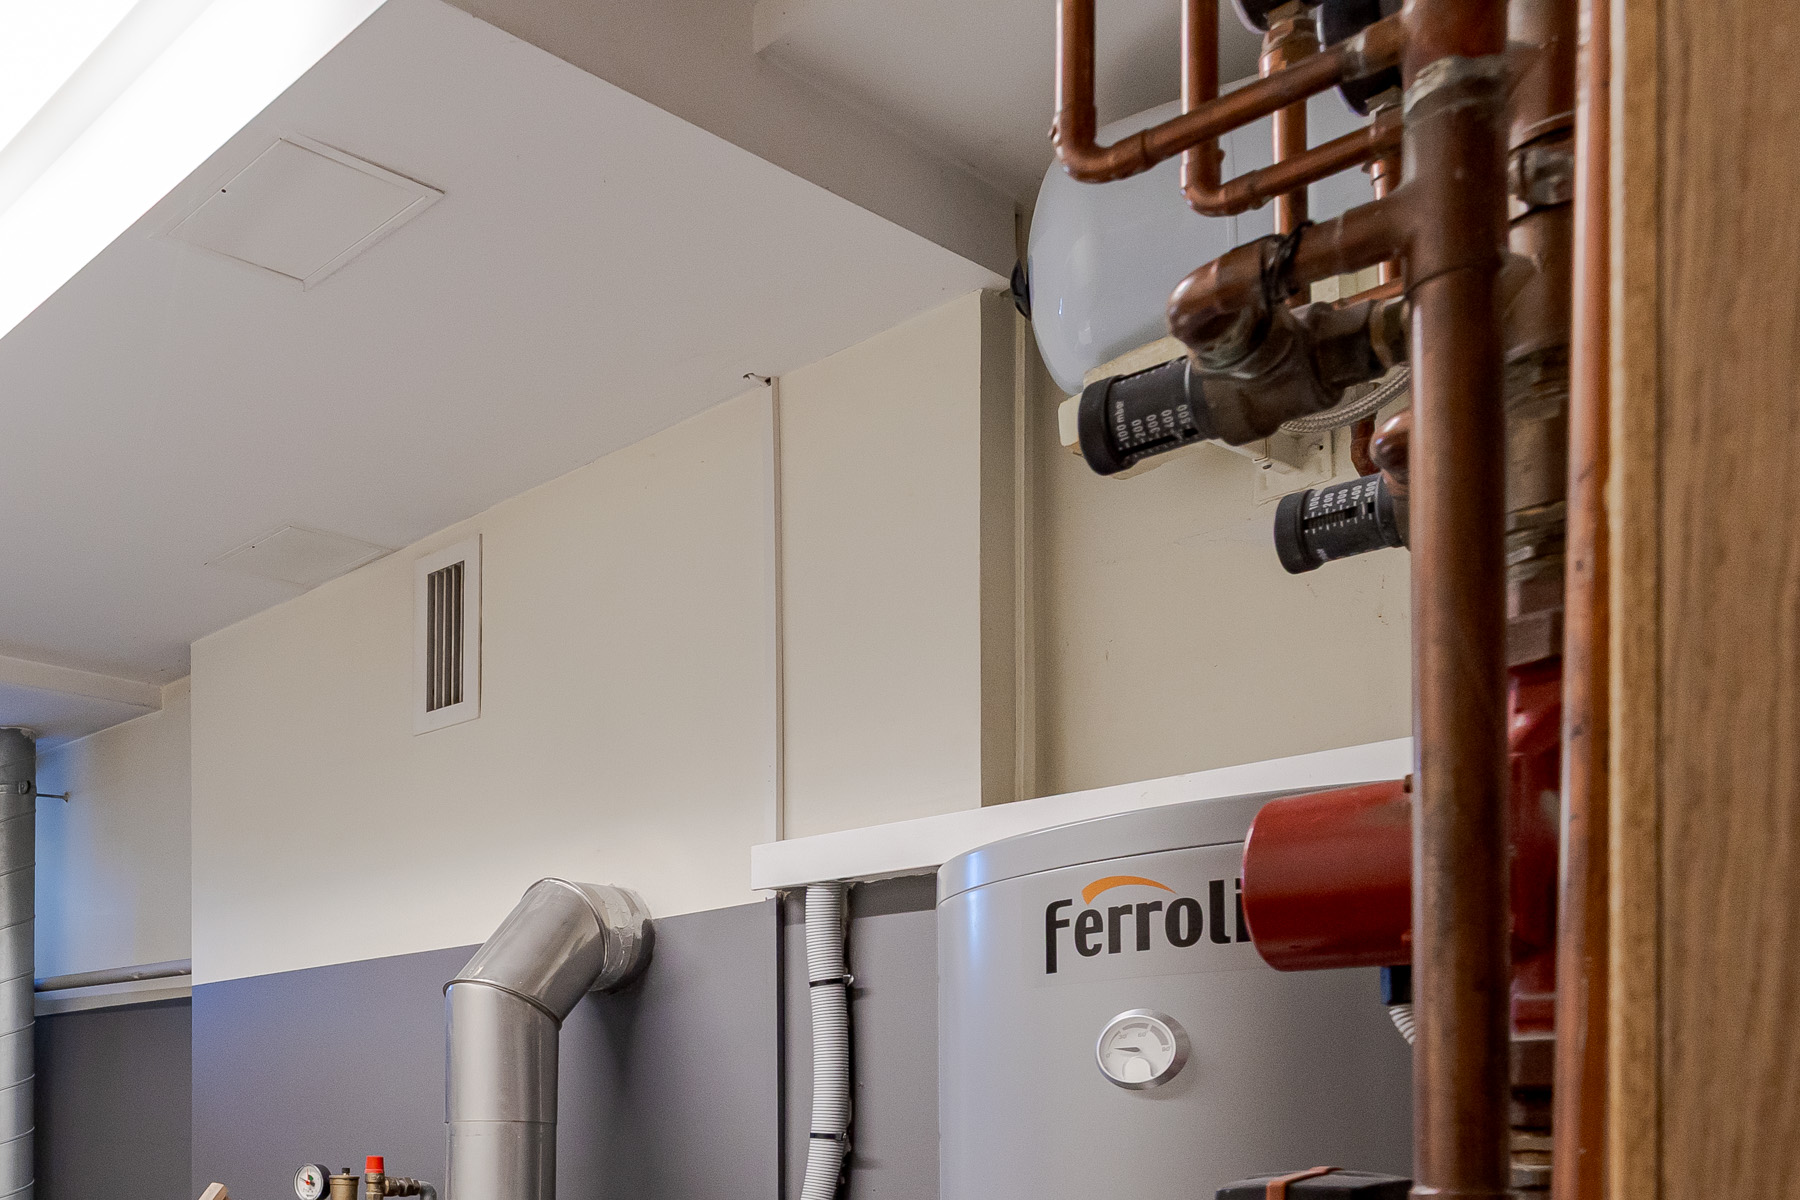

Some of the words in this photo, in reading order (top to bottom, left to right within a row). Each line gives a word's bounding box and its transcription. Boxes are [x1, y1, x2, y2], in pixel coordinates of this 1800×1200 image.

[1161, 409, 1175, 428] 400
[1176, 404, 1191, 424] 500
[1115, 424, 1129, 442] 100
[1131, 419, 1146, 439] 200
[1146, 414, 1161, 434] 300
[1322, 492, 1335, 509] 200
[1337, 489, 1349, 505] 300
[1351, 485, 1363, 500] 400
